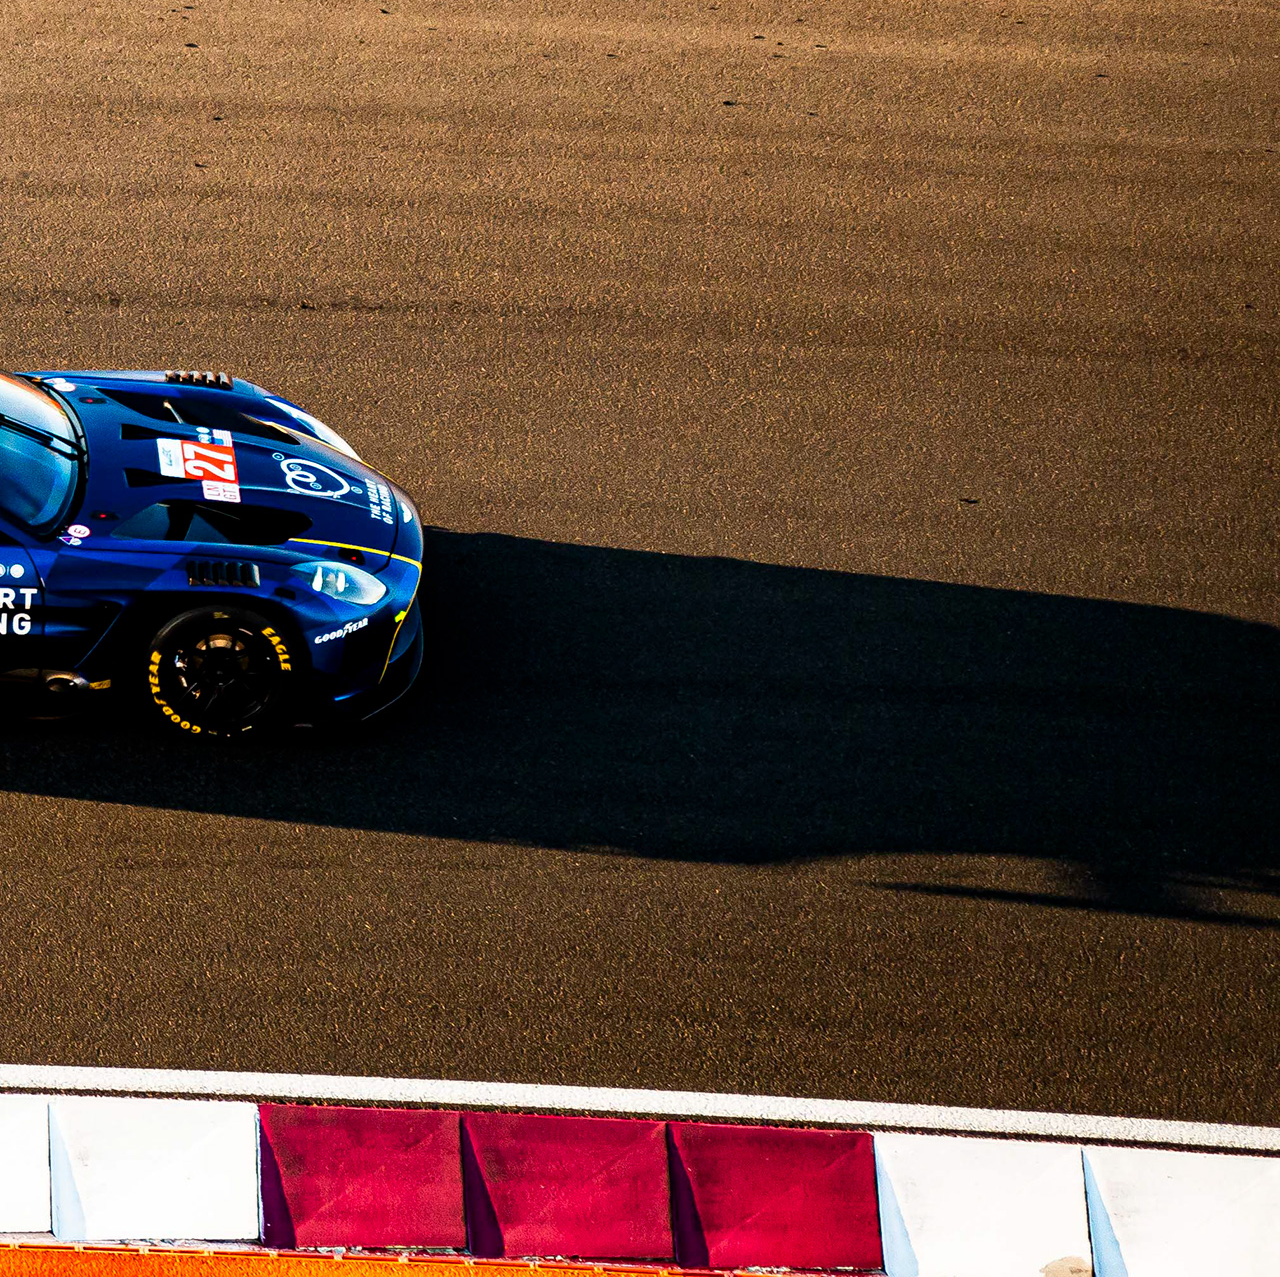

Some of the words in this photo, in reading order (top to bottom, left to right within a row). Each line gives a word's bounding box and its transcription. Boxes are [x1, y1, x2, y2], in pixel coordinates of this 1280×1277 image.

[183, 443, 236, 481] 27
[364, 478, 380, 503] HEART
[369, 503, 382, 520] THE
[382, 511, 394, 525] OF
[314, 617, 369, 644] GOODYEAR
[261, 627, 291, 671] EAGLE
[148, 650, 202, 734] GOODYEAR
